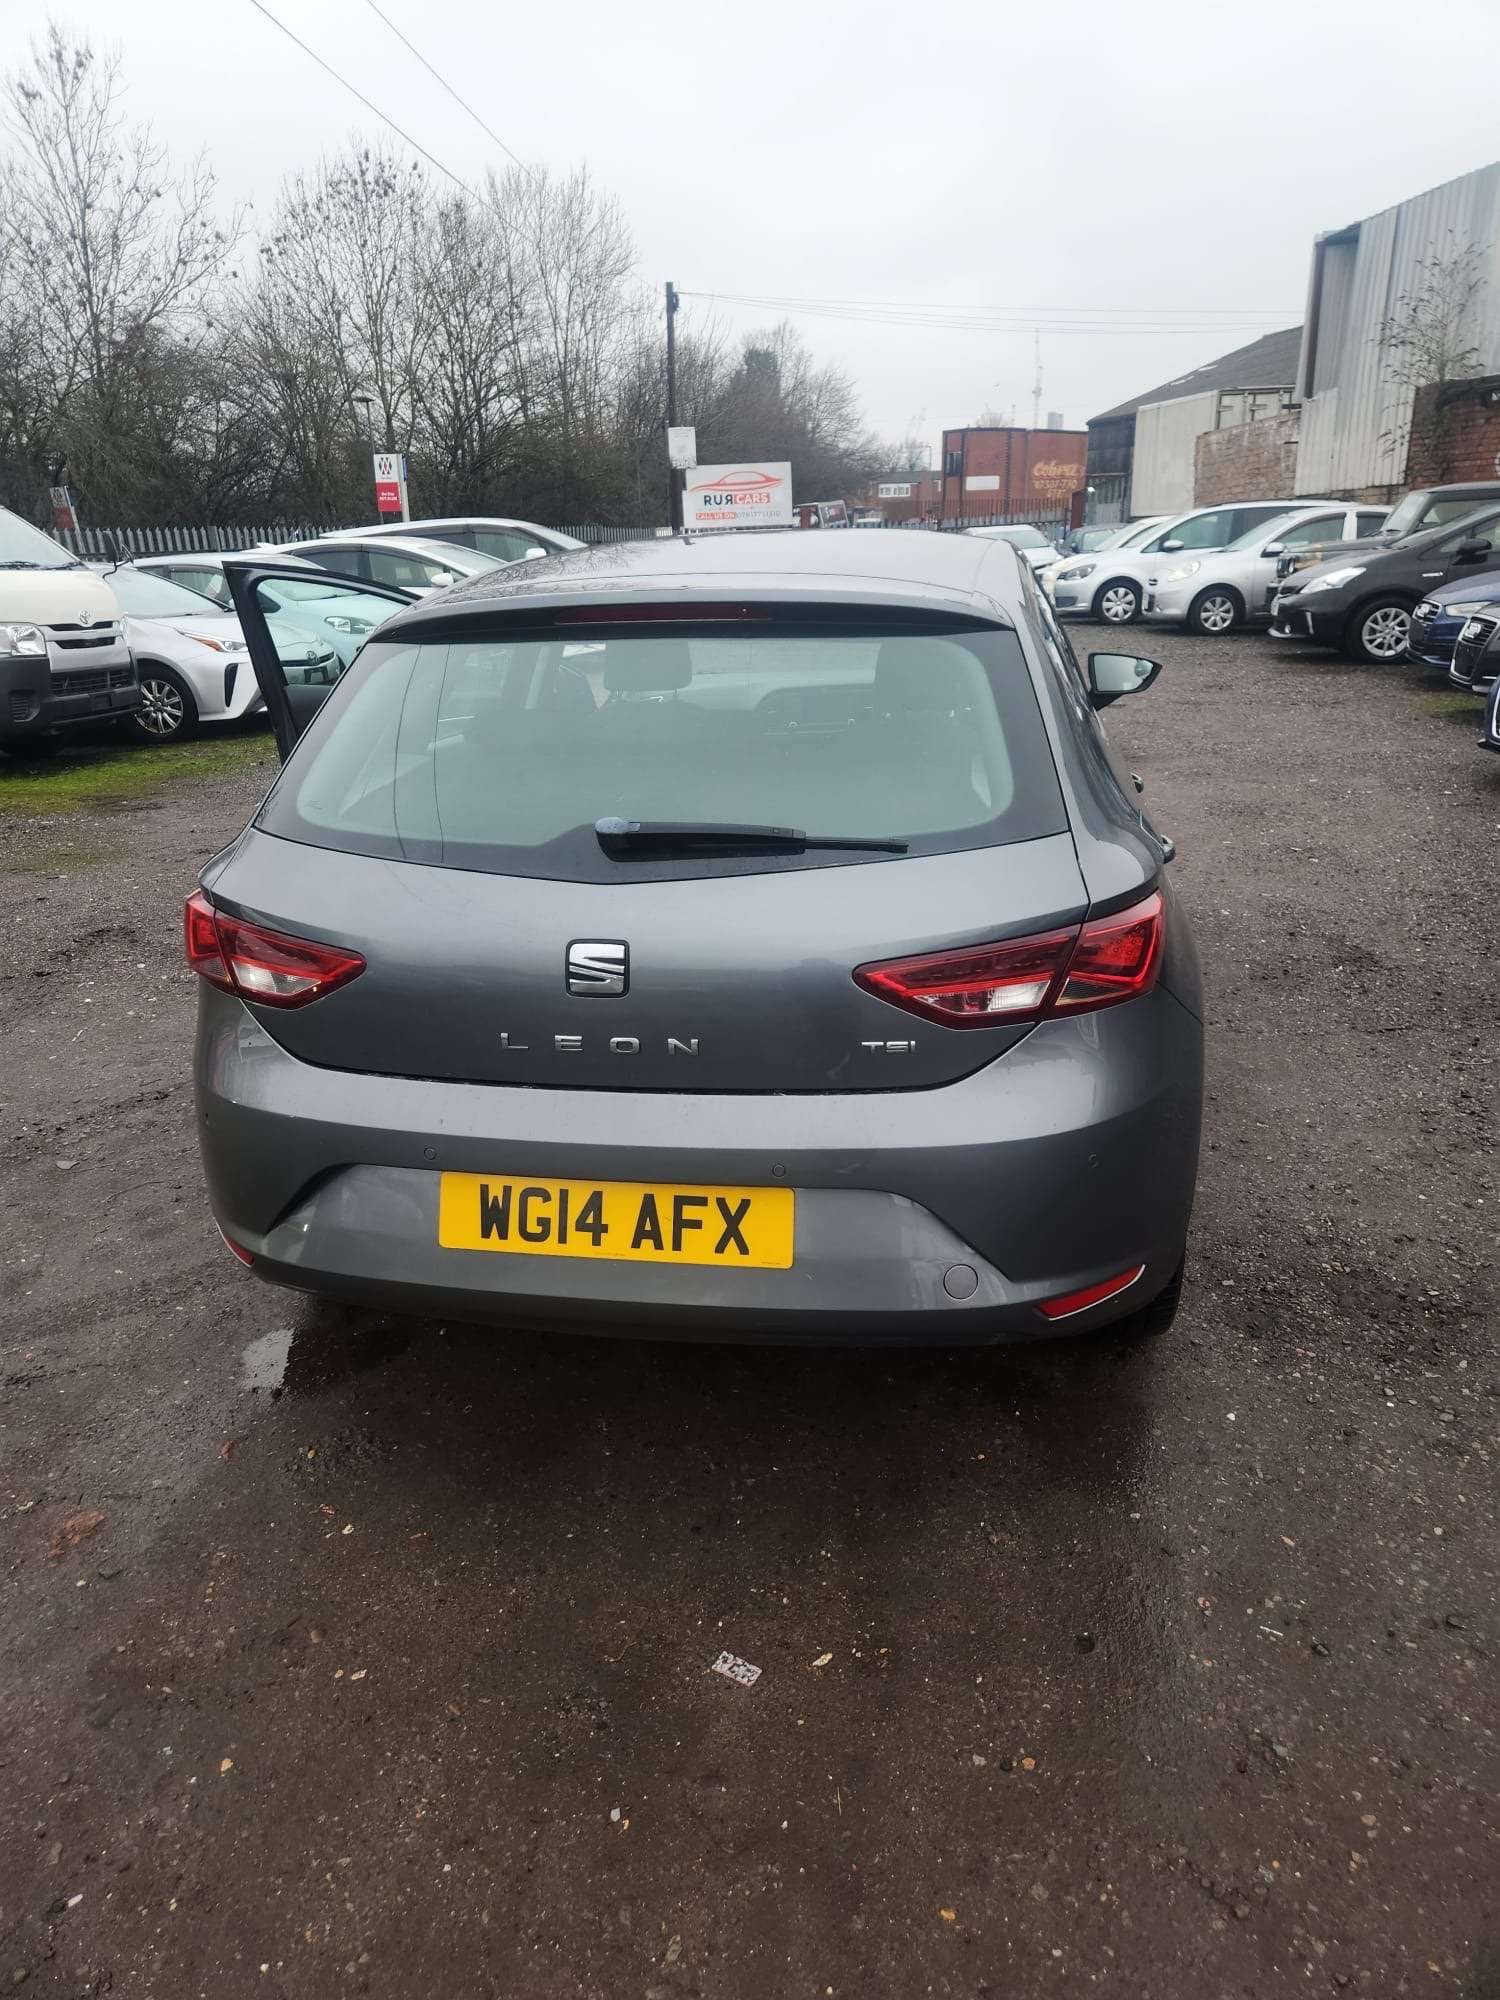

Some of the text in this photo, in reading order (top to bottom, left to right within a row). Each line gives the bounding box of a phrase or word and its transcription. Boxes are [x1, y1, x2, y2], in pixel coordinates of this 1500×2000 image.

[736, 492, 769, 504] CARS
[499, 1032, 699, 1056] LEON
[479, 1183, 752, 1256] WG14 AFX
